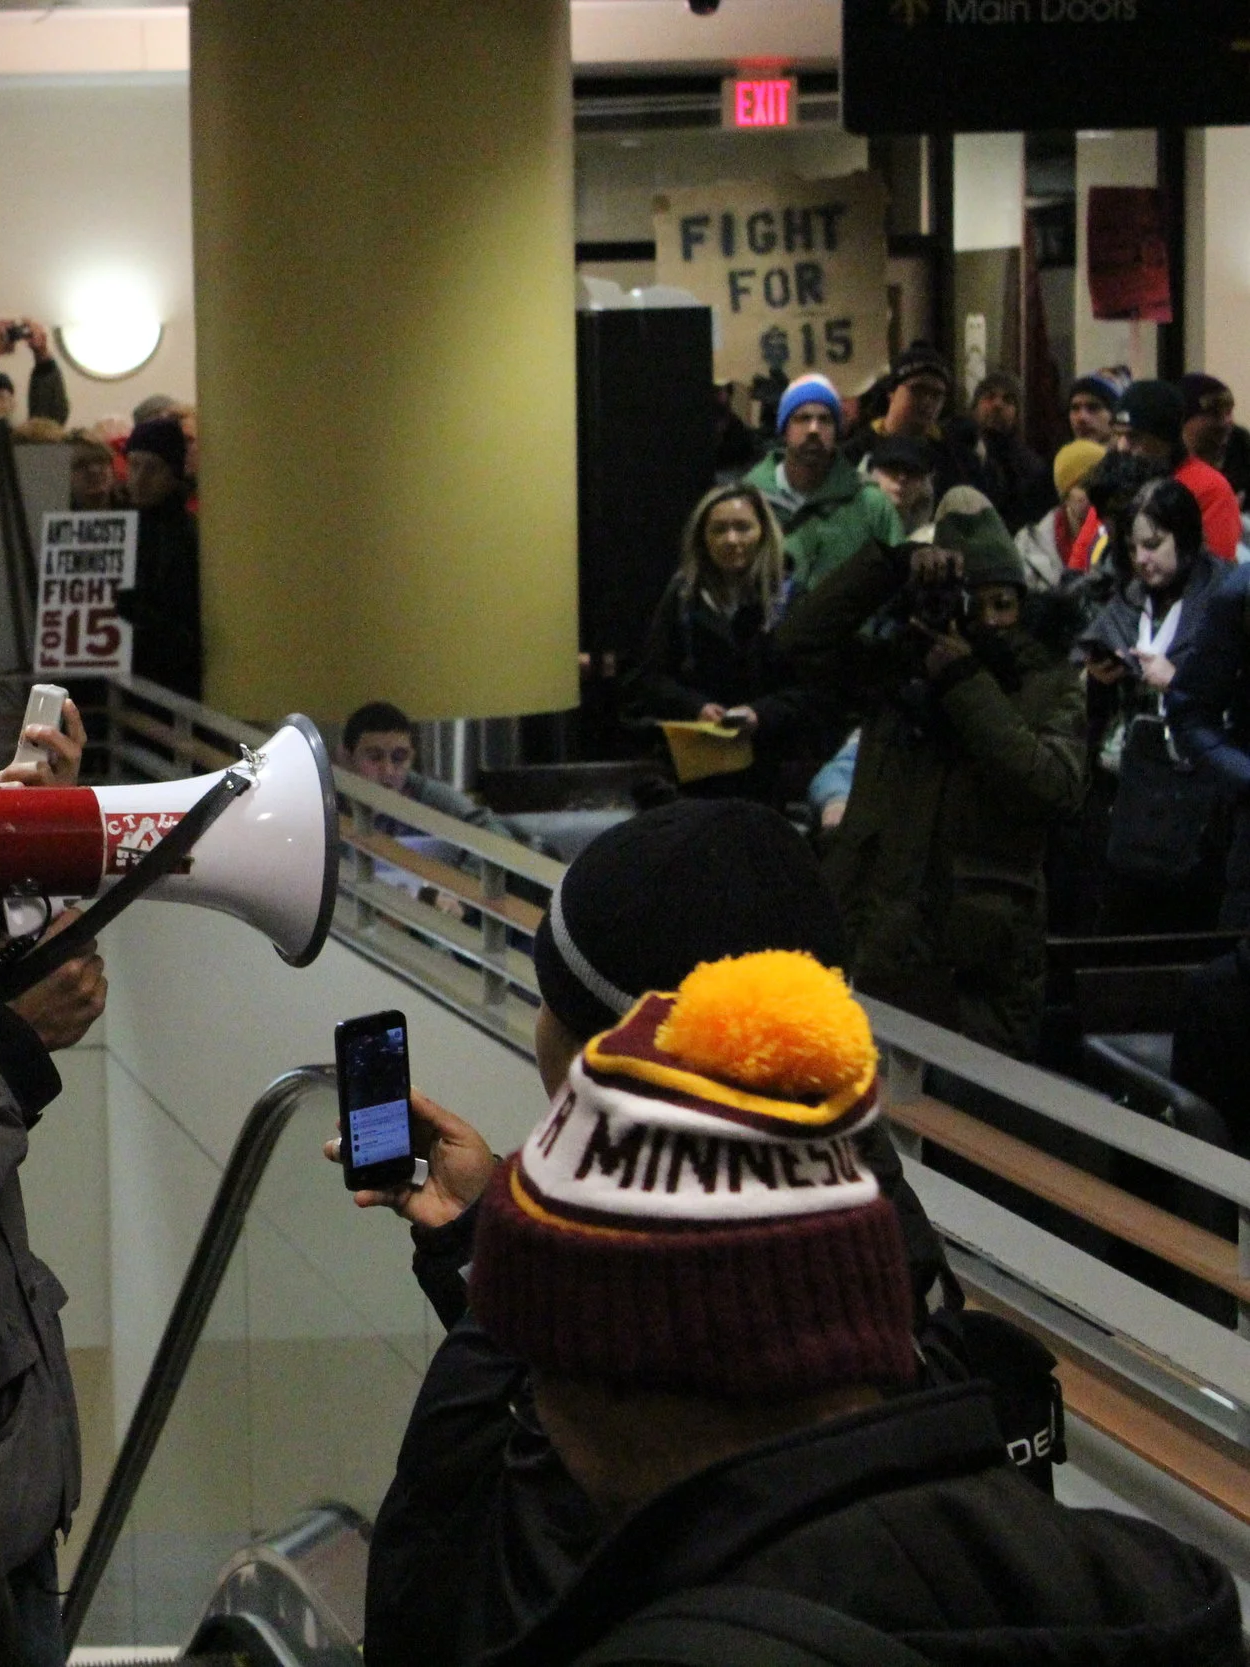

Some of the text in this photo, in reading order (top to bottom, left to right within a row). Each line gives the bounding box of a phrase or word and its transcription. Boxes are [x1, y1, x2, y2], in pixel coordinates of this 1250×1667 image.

[735, 80, 790, 126] EXIT
[681, 203, 847, 260] FIGHT
[728, 262, 824, 312] FOR
[44, 577, 122, 604] FIGHT
[40, 609, 62, 667] FOR
[64, 608, 121, 658] 15
